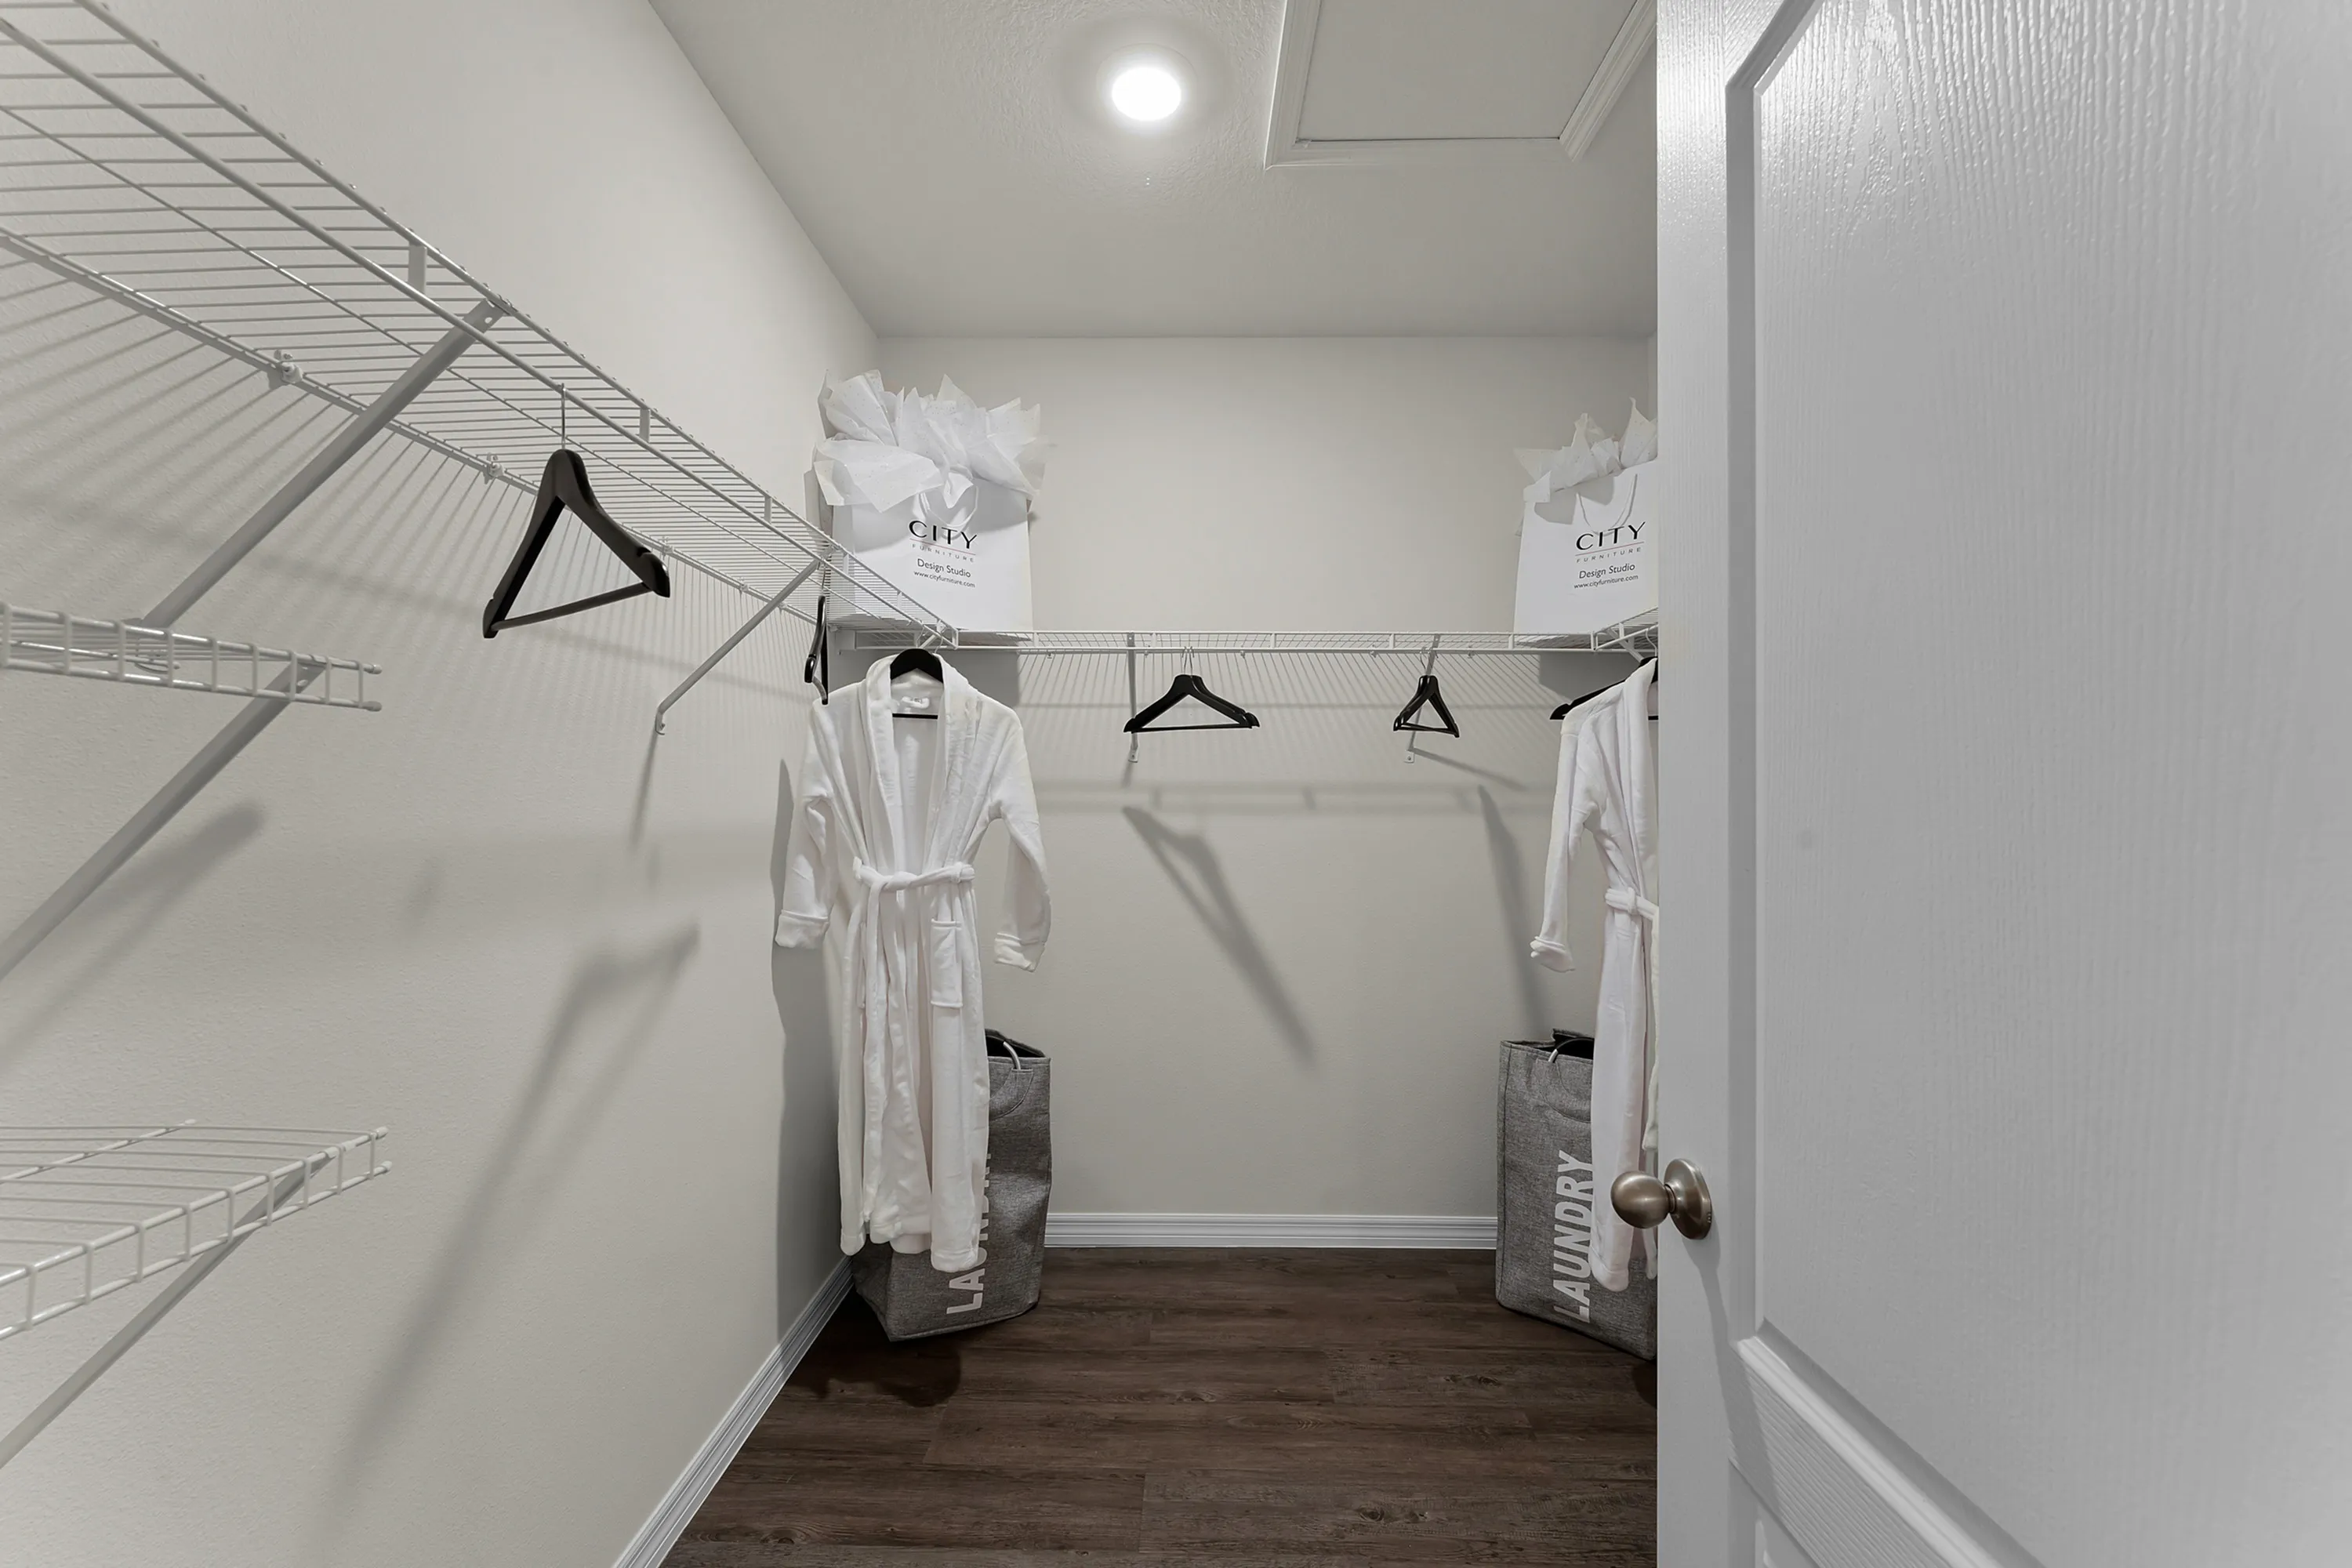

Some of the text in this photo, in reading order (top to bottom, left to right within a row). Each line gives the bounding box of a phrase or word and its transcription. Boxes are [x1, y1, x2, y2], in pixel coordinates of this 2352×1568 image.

[909, 520, 978, 549] CITY
[1576, 521, 1646, 550] CITY
[912, 544, 975, 563] FURNITURE
[1577, 546, 1641, 563] FURNITURE
[917, 558, 971, 578] Design Studio
[1579, 563, 1635, 579] Design Studio
[913, 570, 975, 588] www.cityfurniture.com
[1573, 575, 1639, 589] www.cityfurniture.com
[1552, 1149, 1595, 1324] LAUNDRY
